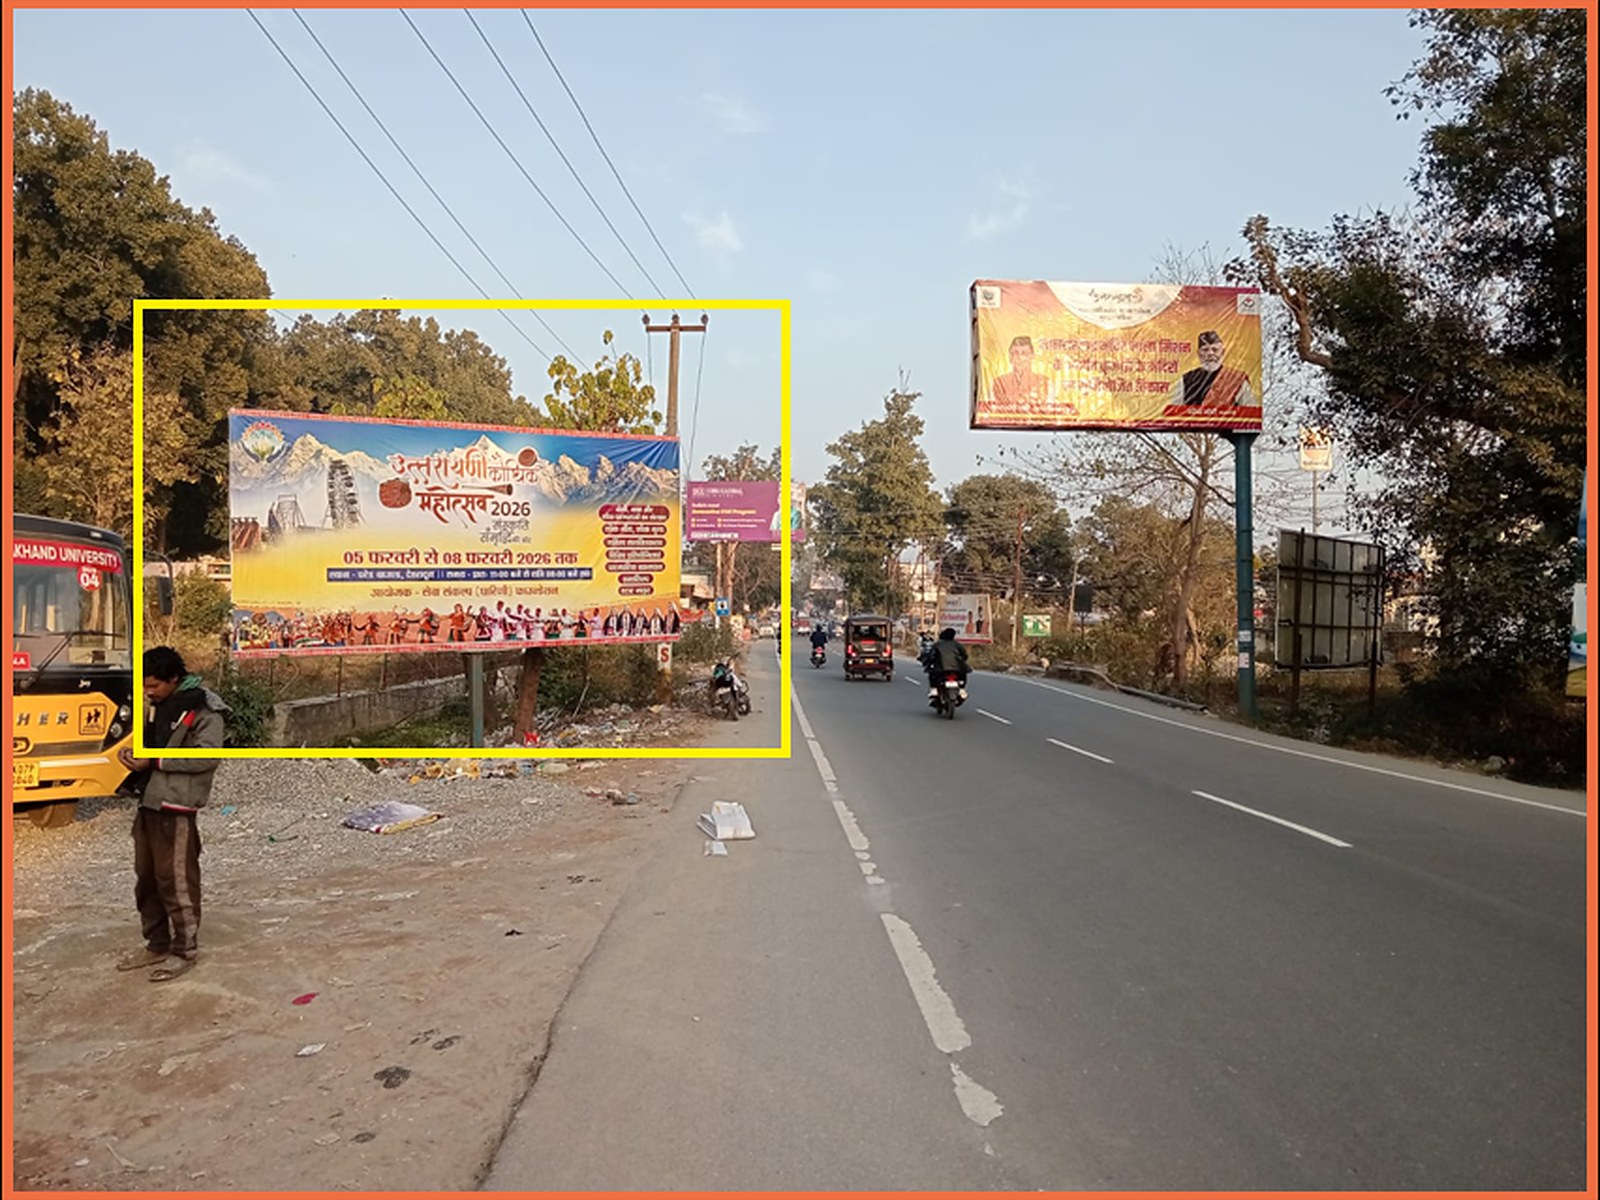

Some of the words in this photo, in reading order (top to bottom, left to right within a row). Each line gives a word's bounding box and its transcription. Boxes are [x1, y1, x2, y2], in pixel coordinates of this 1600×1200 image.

[415, 485, 495, 529] महोत्सव
[491, 501, 531, 517] 2026
[13, 543, 58, 561] KHAND
[59, 547, 117, 568] UNIVERSITY
[343, 551, 364, 565] 05
[368, 547, 420, 565] फरवरी
[424, 547, 438, 565] से
[443, 552, 462, 565] 08
[465, 548, 513, 565] फरवरी
[516, 552, 552, 565] 2026
[554, 552, 578, 564] तक
[80, 573, 100, 587] 04
[660, 647, 670, 663] S
